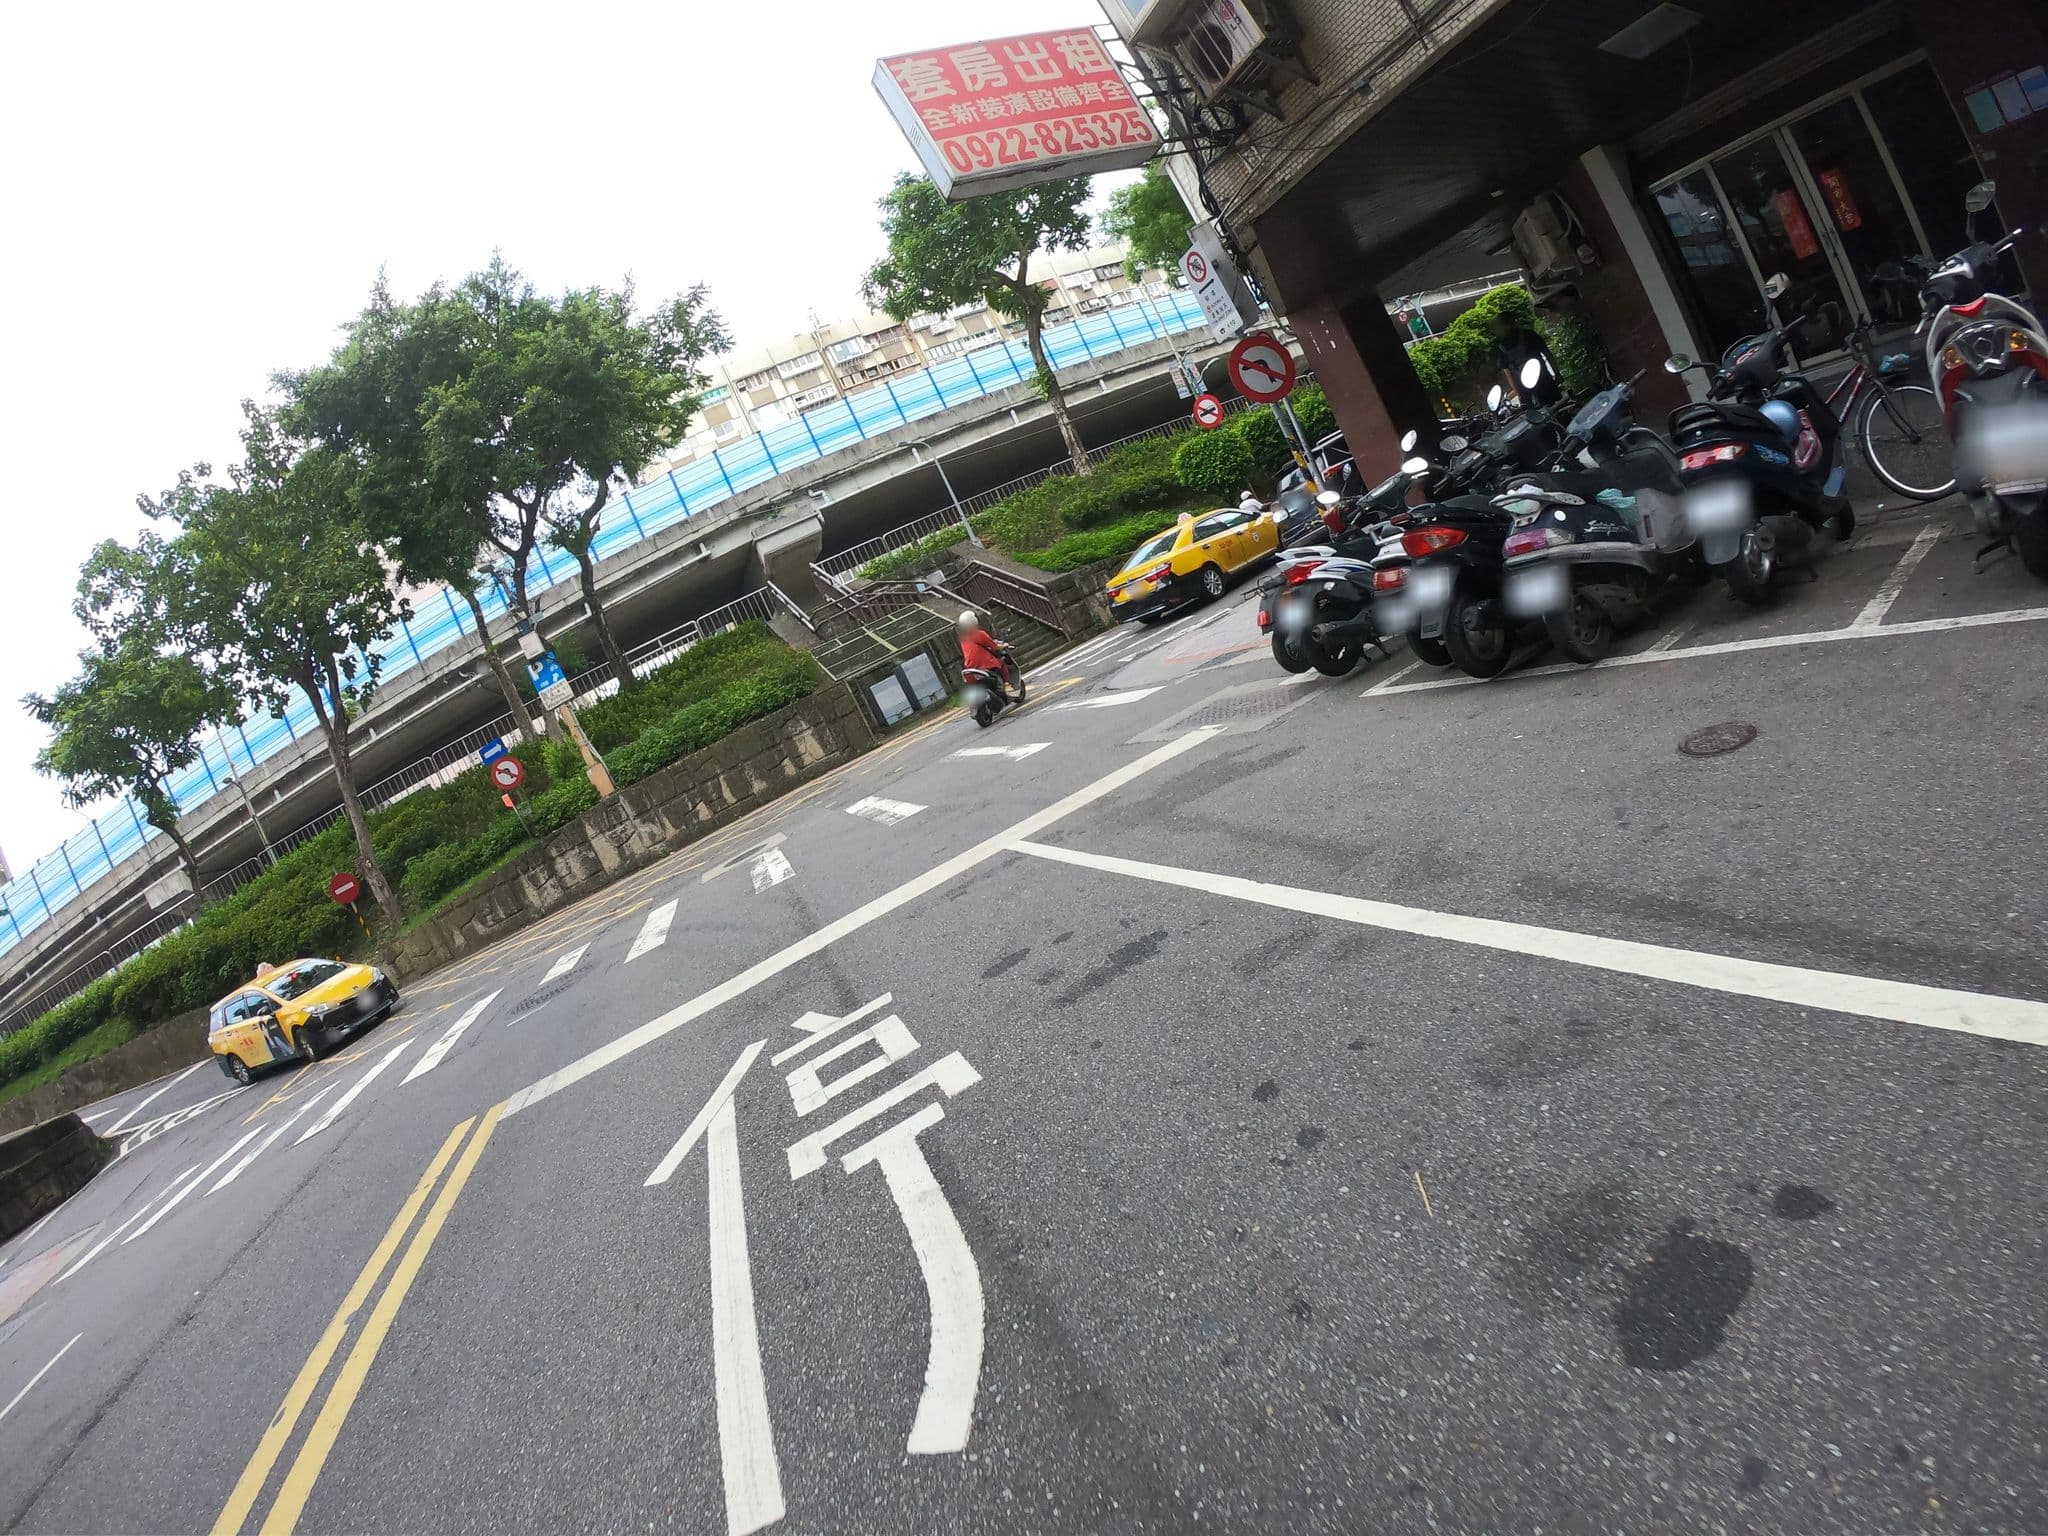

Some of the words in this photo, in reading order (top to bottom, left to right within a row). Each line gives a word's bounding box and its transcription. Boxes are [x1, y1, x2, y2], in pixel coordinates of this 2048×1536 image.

[890, 33, 1114, 102] 套房出租
[921, 79, 1133, 131] 全新裝潢設備齊全
[943, 111, 1153, 173] 0922-825325
[643, 991, 985, 1535] 停
